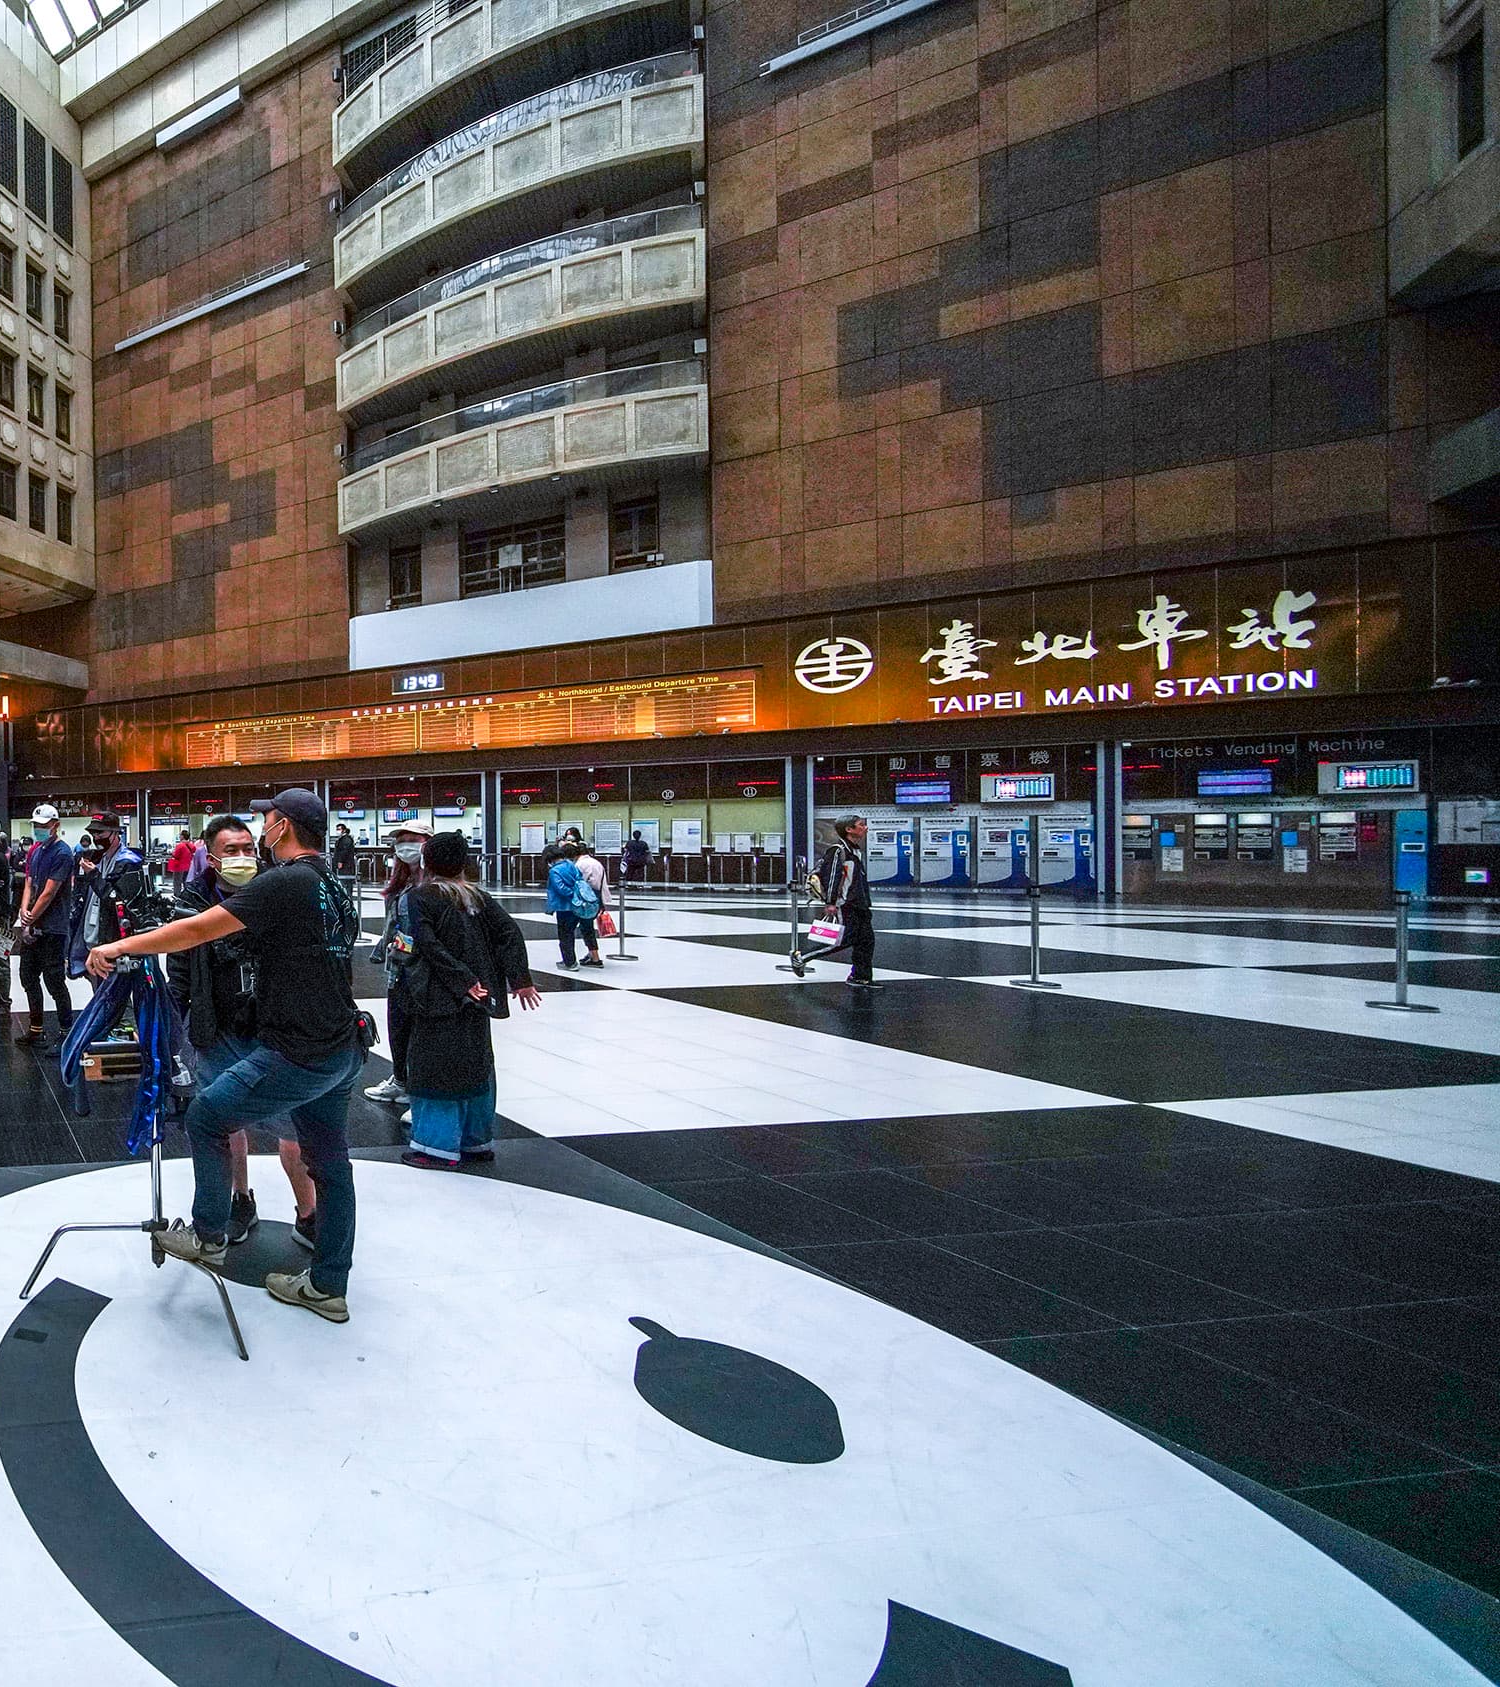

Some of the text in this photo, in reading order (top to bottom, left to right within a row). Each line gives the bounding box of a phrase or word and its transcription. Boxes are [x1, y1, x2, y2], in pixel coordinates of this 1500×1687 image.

[920, 590, 1317, 686] 臺北車站
[558, 687, 603, 697] Northbound
[609, 682, 652, 692] Eastbound
[653, 678, 695, 687] Departure
[929, 668, 1317, 714] TAIPEI MAIN STATION
[227, 720, 264, 728] Southbound
[265, 717, 297, 725] Departure
[1148, 737, 1385, 760] Tickets Vending Machine
[846, 751, 1049, 773] 自動售票機
